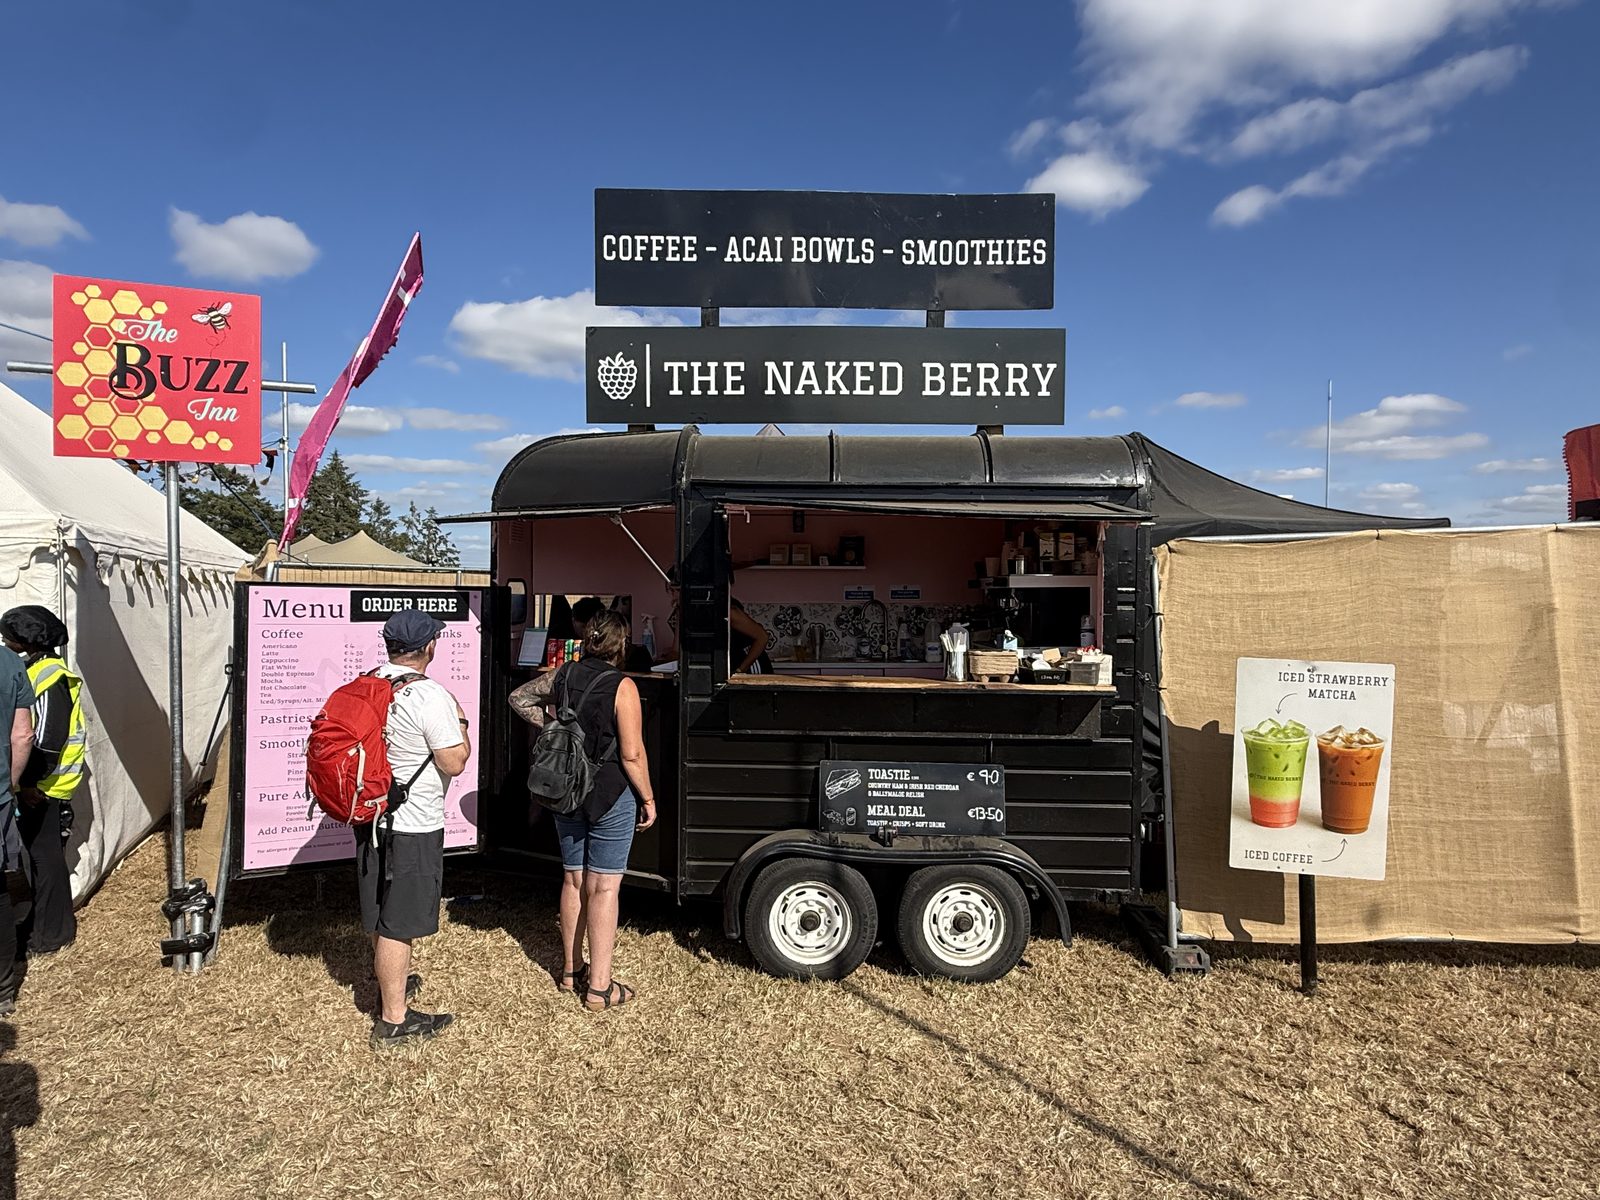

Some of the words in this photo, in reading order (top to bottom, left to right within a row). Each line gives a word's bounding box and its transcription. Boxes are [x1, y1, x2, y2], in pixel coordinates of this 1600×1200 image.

[602, 234, 698, 262] COFFEE
[723, 235, 783, 262] ACAI
[791, 236, 875, 264] BOWLS
[901, 238, 1047, 266] SMOOTHIES
[118, 319, 178, 343] The
[663, 361, 745, 395] THE
[764, 361, 904, 395] NAKED
[921, 362, 1058, 397] BERRY
[187, 397, 240, 422] Inn
[262, 598, 345, 619] Menu
[361, 597, 413, 612] ORDER
[416, 598, 458, 613] HERE
[261, 628, 304, 639] Coffee
[1278, 671, 1305, 683] ICED
[1308, 673, 1389, 687] STRAWBERRY
[1307, 688, 1357, 701] MATCHA
[260, 714, 313, 724] Pastries
[867, 768, 911, 780] TOASTIE
[966, 772, 975, 781] €
[258, 792, 289, 802] Pure
[867, 804, 897, 816] MEAL
[898, 805, 926, 817] DEAL
[257, 827, 278, 836] Add
[281, 824, 315, 834] Peanut
[1244, 849, 1269, 861] ICED
[1272, 851, 1313, 864] COFFEE
